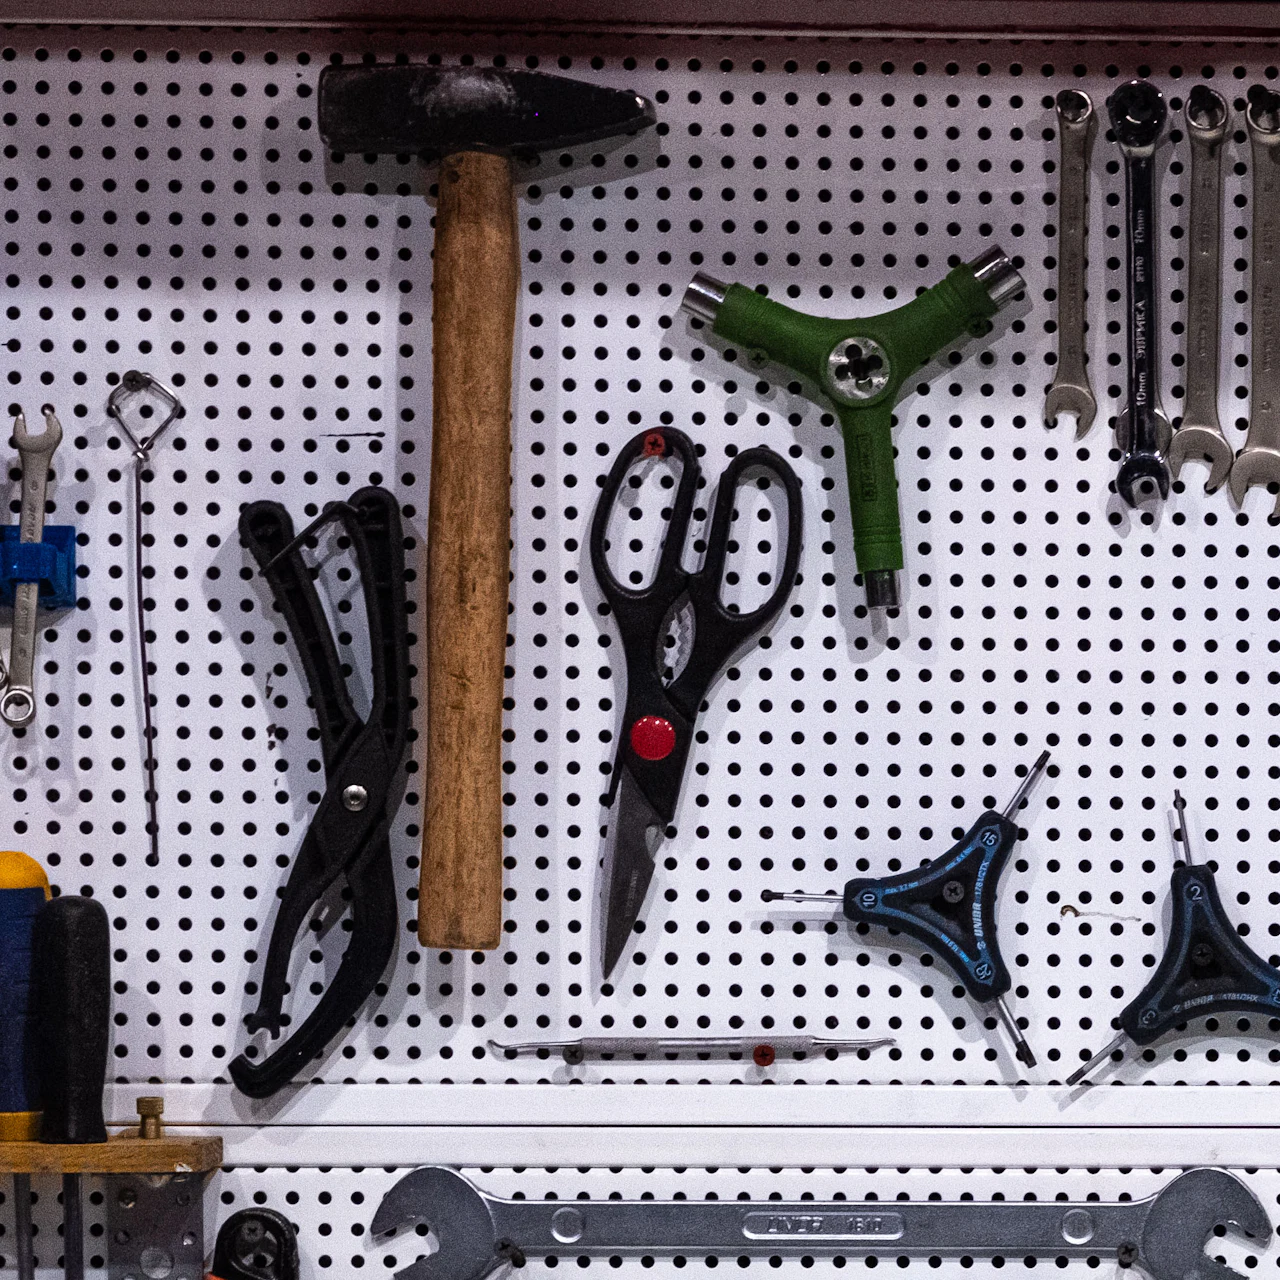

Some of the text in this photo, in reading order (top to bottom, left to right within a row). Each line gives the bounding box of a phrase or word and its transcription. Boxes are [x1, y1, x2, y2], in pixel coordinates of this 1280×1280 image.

[981, 832, 998, 847] 15
[862, 893, 876, 907] 10
[1189, 886, 1202, 900] 2
[972, 902, 984, 938] UNIOR
[1142, 1011, 1156, 1024] 3
